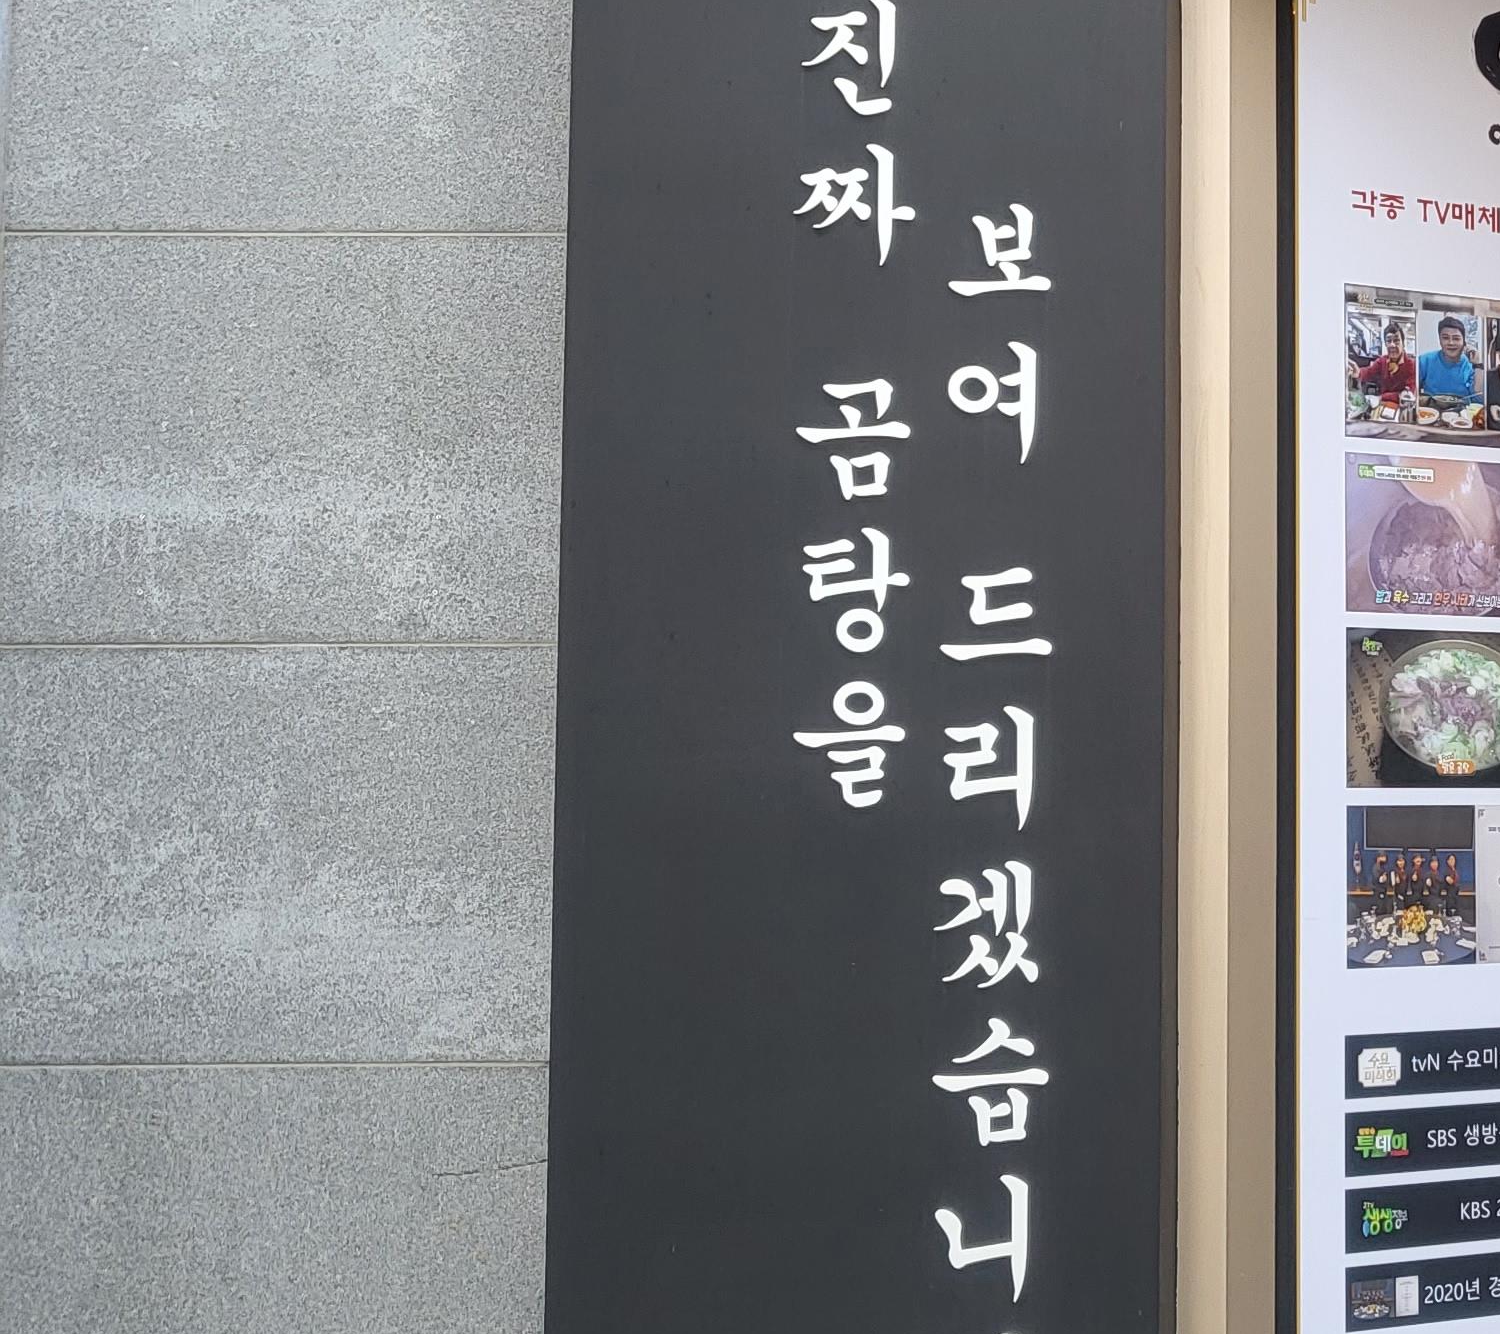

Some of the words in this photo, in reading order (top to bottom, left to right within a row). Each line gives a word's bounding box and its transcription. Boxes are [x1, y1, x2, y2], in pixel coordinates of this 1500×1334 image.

[1351, 189, 1405, 220] 각종
[947, 203, 1052, 465] 보여
[793, 378, 911, 809] 곰탕을
[1412, 1053, 1440, 1073] tvN
[1427, 1128, 1457, 1149] SBS
[1460, 1200, 1490, 1220] KBS
[1424, 1279, 1481, 1305] 2020년
